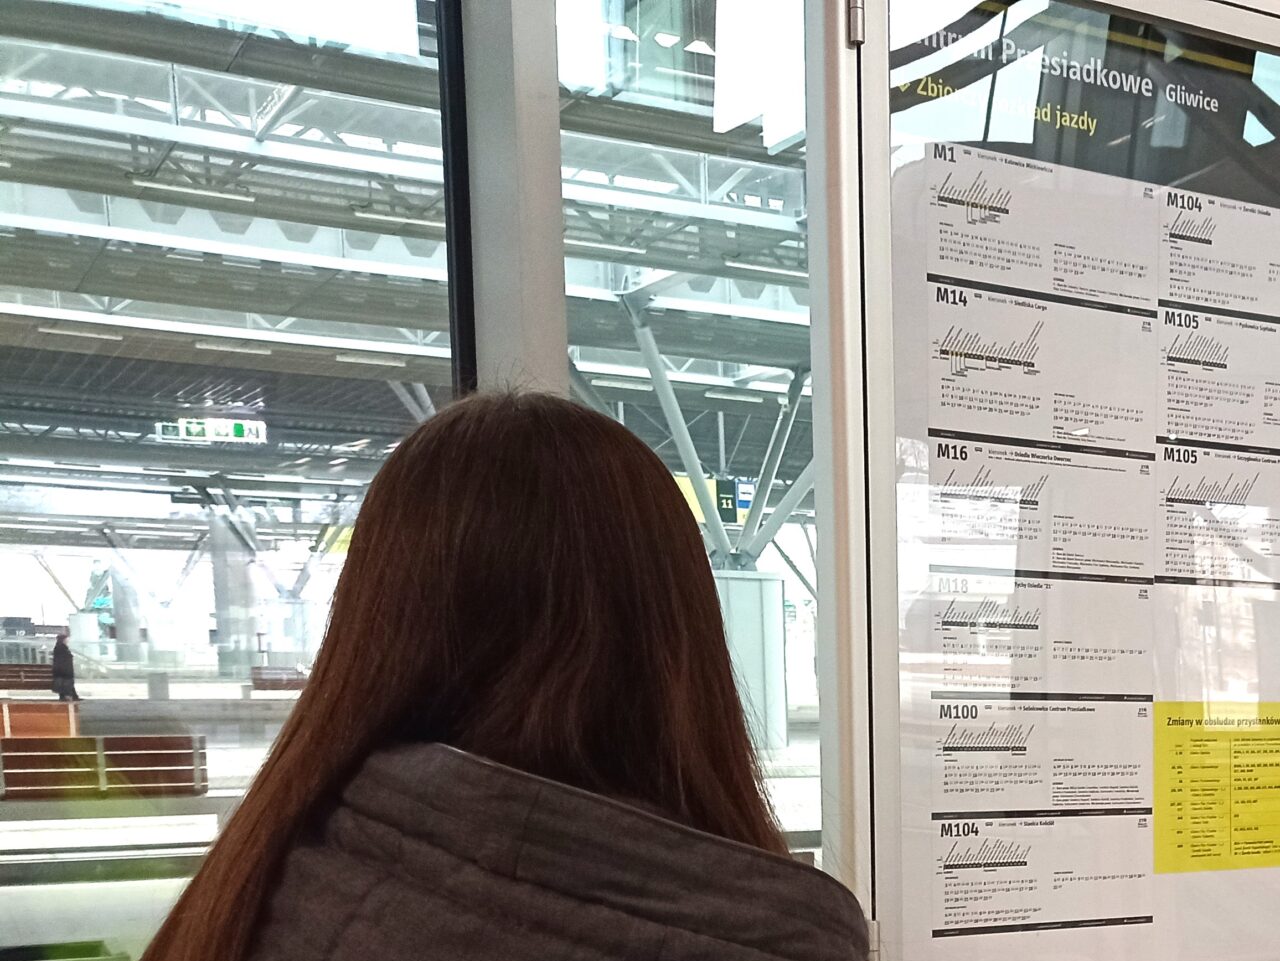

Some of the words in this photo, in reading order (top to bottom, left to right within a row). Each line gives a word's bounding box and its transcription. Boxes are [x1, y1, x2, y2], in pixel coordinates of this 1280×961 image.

[1002, 37, 1153, 97] Presiadkowe
[1165, 83, 1219, 112] Gliwice
[1055, 105, 1097, 137] jazdy
[933, 143, 956, 163] M1
[1166, 191, 1203, 213] M104
[936, 287, 968, 307] M14
[1164, 310, 1199, 329] M105
[936, 443, 968, 461] M16
[1163, 447, 1198, 464] M105
[938, 577, 969, 594] M18
[939, 704, 978, 719] M100
[1166, 716, 1193, 728] Zmiany
[1195, 718, 1203, 726] w
[1237, 716, 1280, 728] przystanków
[940, 822, 980, 838] M104
